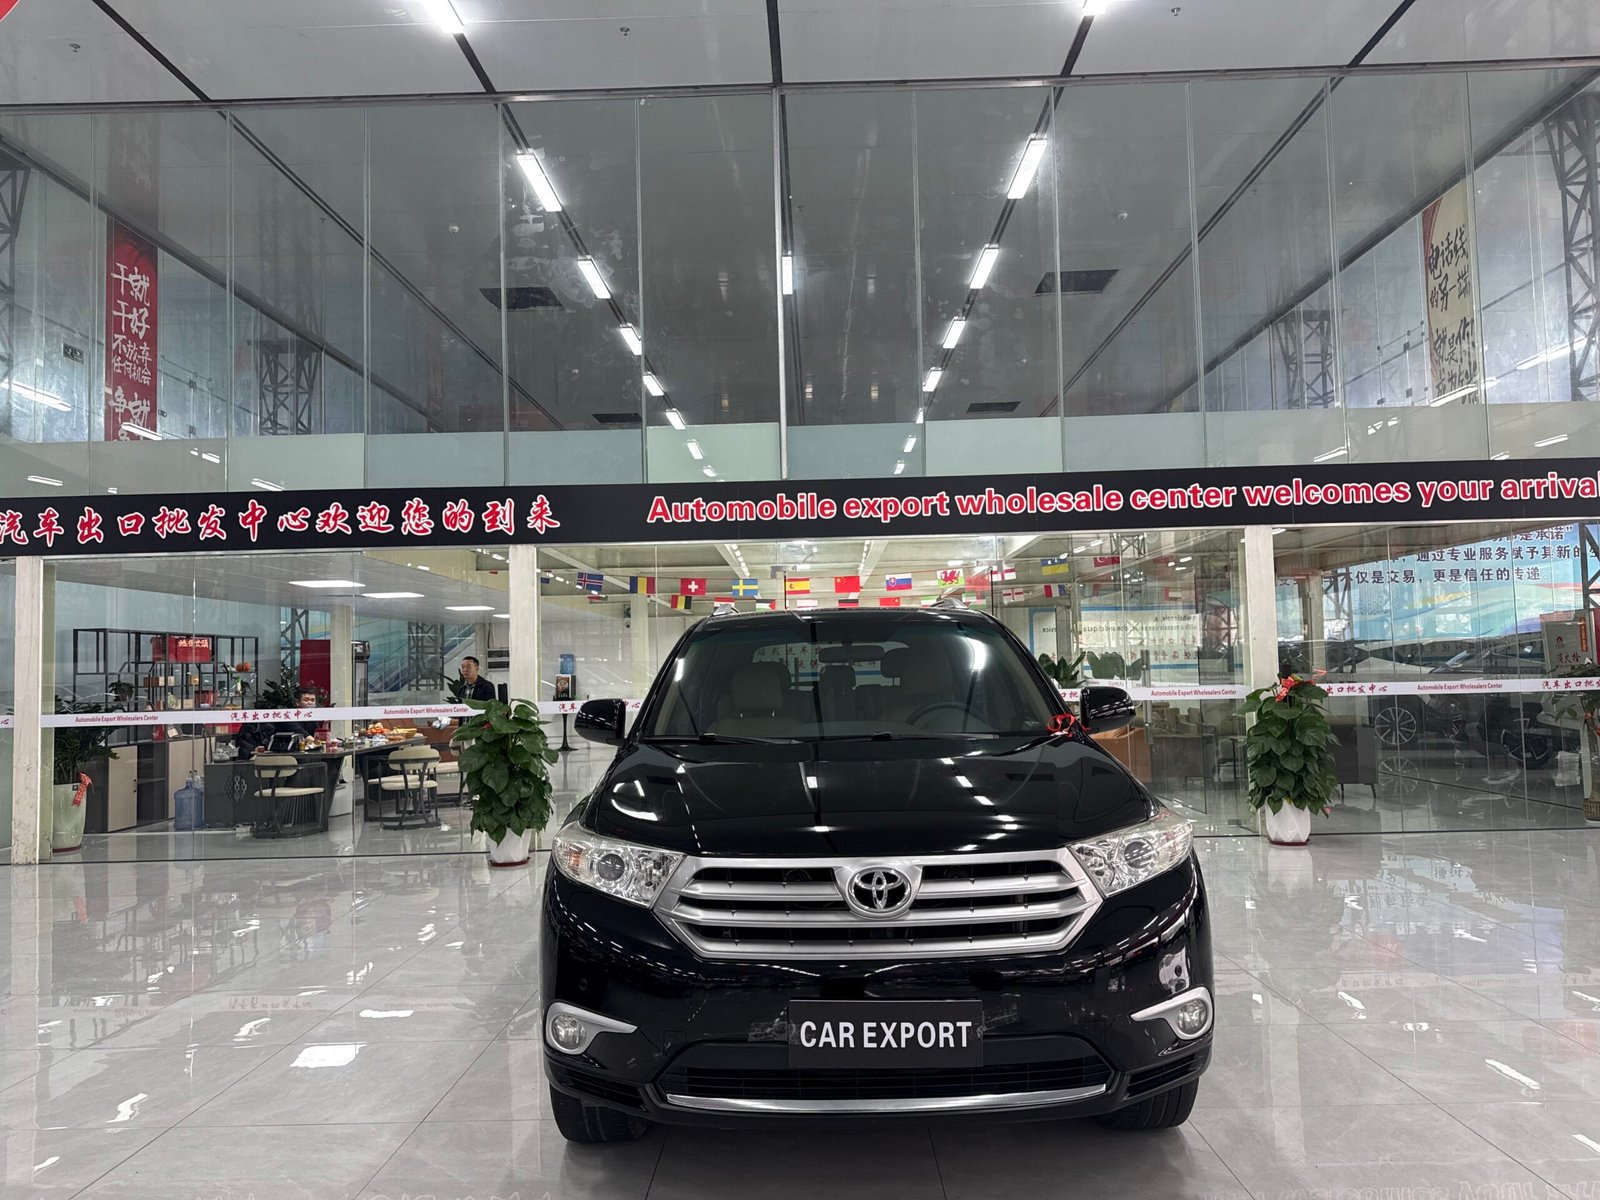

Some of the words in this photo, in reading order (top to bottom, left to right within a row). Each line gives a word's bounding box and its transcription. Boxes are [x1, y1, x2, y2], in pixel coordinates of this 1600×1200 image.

[647, 492, 837, 523] Automobile
[843, 491, 950, 523] export
[954, 483, 1124, 516] wholesale
[1129, 483, 1237, 510] center
[1242, 477, 1411, 507] welcomes
[1417, 477, 1494, 508] your
[1500, 471, 1600, 500] arriva
[0, 494, 560, 547] 汽车出口批发中心欢迎您的到来
[1178, 689, 1193, 697] Export
[230, 709, 313, 721] 汽车出口批发中心
[410, 707, 425, 715] Export
[426, 706, 453, 714] Wholesalers
[101, 715, 116, 723] Export
[116, 714, 143, 722] Wholesalers
[800, 1020, 855, 1048] CAR
[863, 1020, 973, 1048] EXPORT
